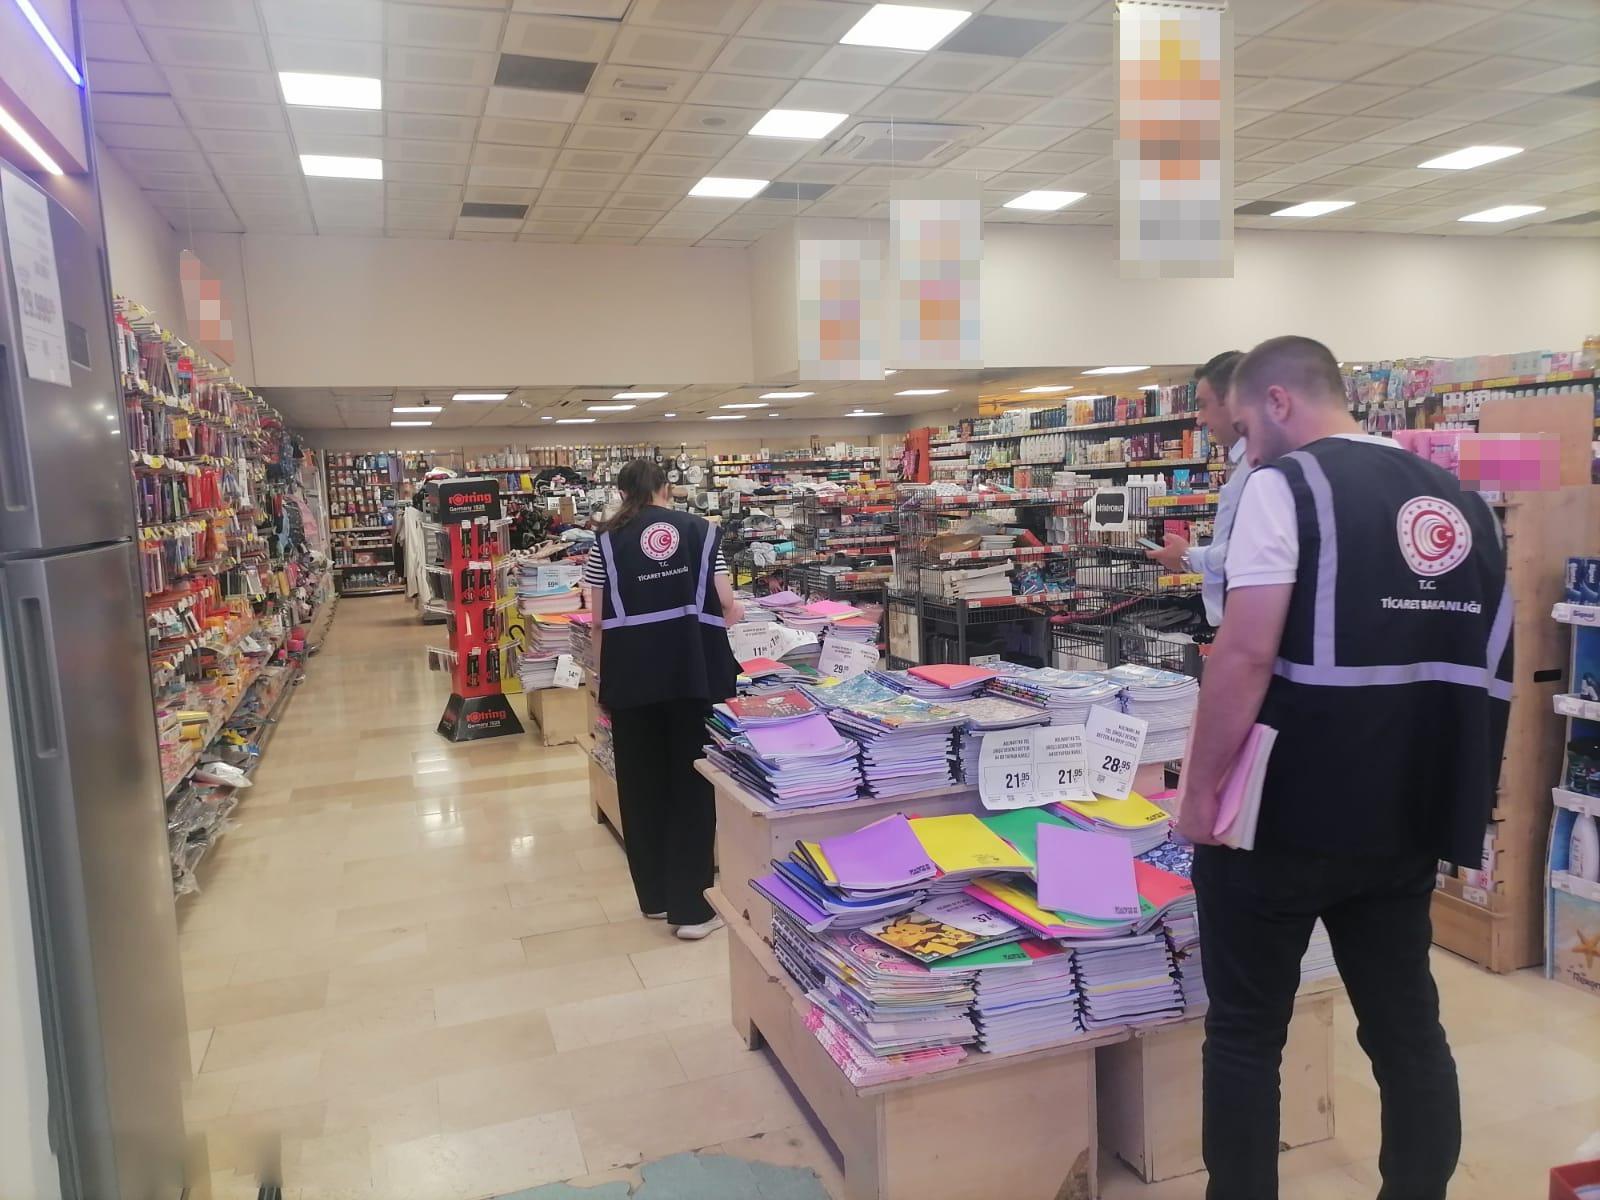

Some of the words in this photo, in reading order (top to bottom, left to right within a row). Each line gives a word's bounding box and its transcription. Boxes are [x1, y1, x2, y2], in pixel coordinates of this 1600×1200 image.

[448, 492, 492, 506] rotring
[1381, 596, 1420, 610] TİCARET
[1421, 600, 1482, 614] BAKANLIĞI
[465, 709, 506, 723] rotring
